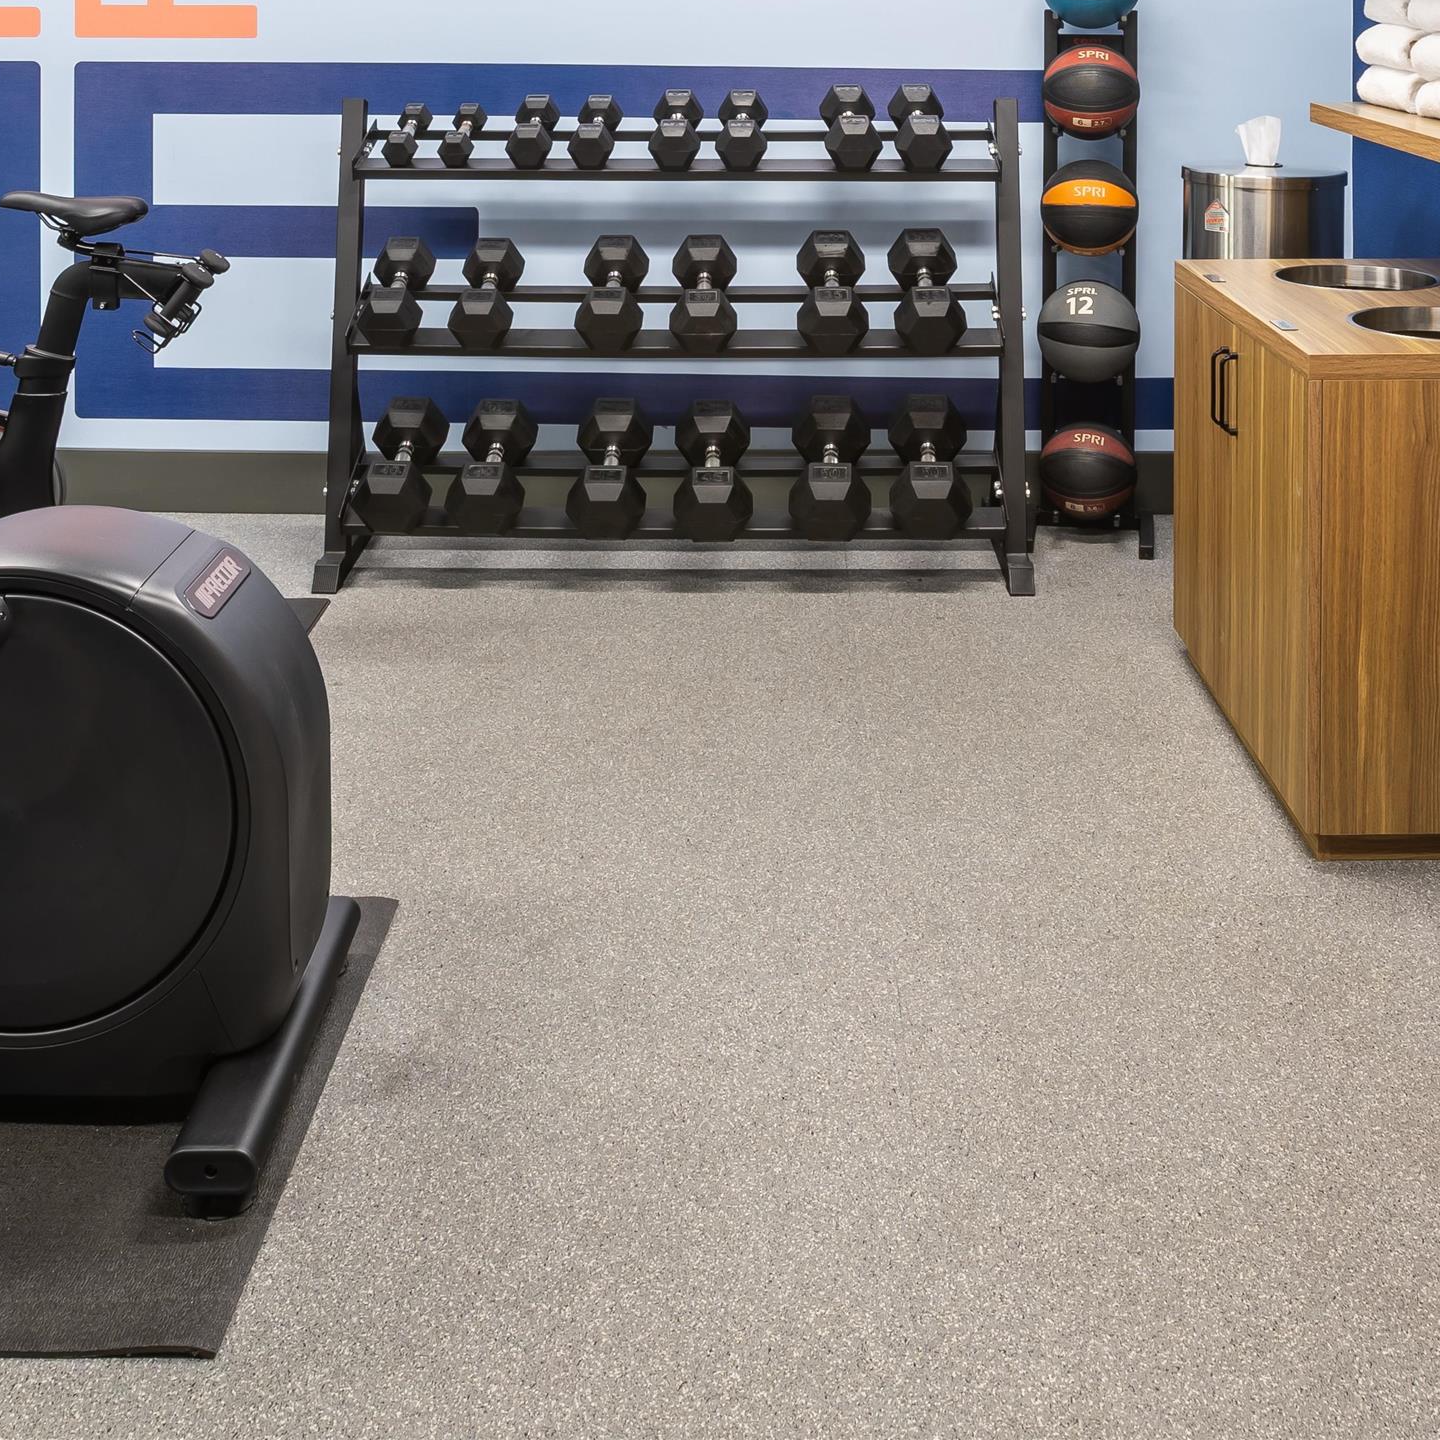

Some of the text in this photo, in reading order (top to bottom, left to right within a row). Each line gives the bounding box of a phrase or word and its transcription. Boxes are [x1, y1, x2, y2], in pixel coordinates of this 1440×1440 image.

[1077, 50, 1110, 61] SPRI
[1073, 186, 1106, 198] SPRI
[1066, 296, 1094, 315] 12
[1073, 433, 1105, 447] SPRI
[194, 555, 243, 610] PRECOR
